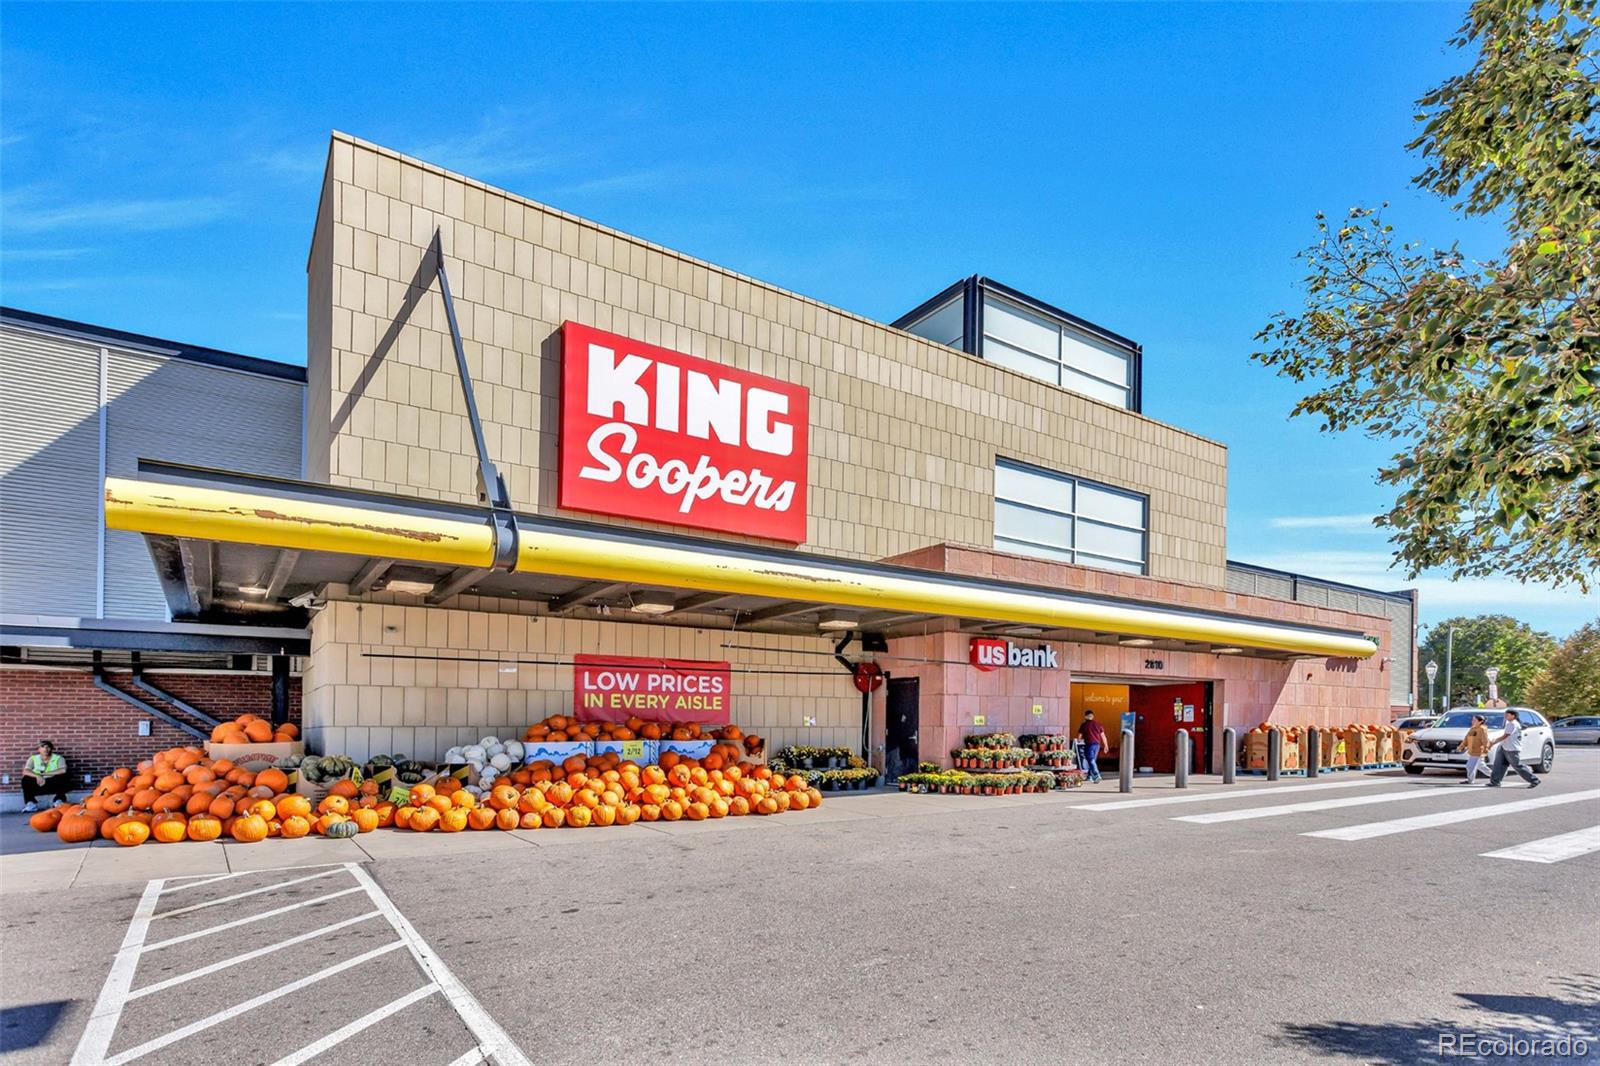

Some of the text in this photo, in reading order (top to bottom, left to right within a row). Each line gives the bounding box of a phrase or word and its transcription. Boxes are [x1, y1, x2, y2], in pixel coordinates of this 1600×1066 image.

[587, 343, 793, 456] KING
[578, 422, 796, 513] Soopers
[584, 671, 724, 693] LOW PRICES
[584, 693, 723, 710] IN EVERY AISLE
